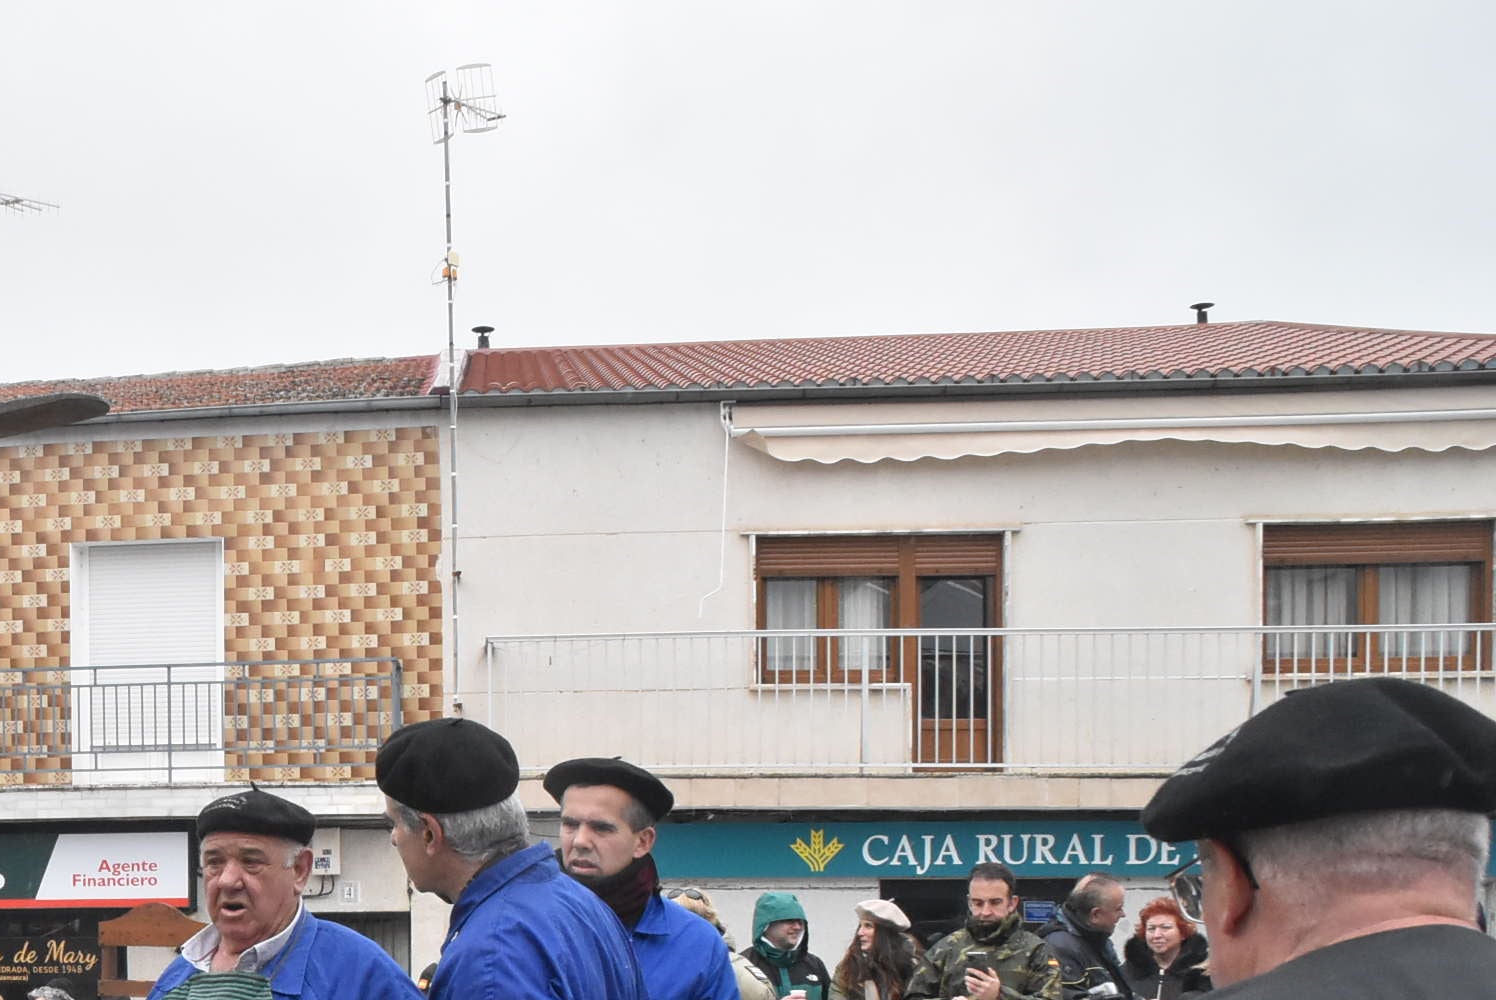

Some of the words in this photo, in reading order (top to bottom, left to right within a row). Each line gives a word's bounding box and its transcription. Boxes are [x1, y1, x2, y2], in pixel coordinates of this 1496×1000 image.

[862, 834, 963, 875] CAJA
[975, 833, 1114, 866] RURAL
[1125, 834, 1181, 866] DE
[98, 859, 158, 876] Agente
[72, 873, 158, 887] Financiero
[13, 941, 38, 964] de
[44, 940, 99, 970] Mary
